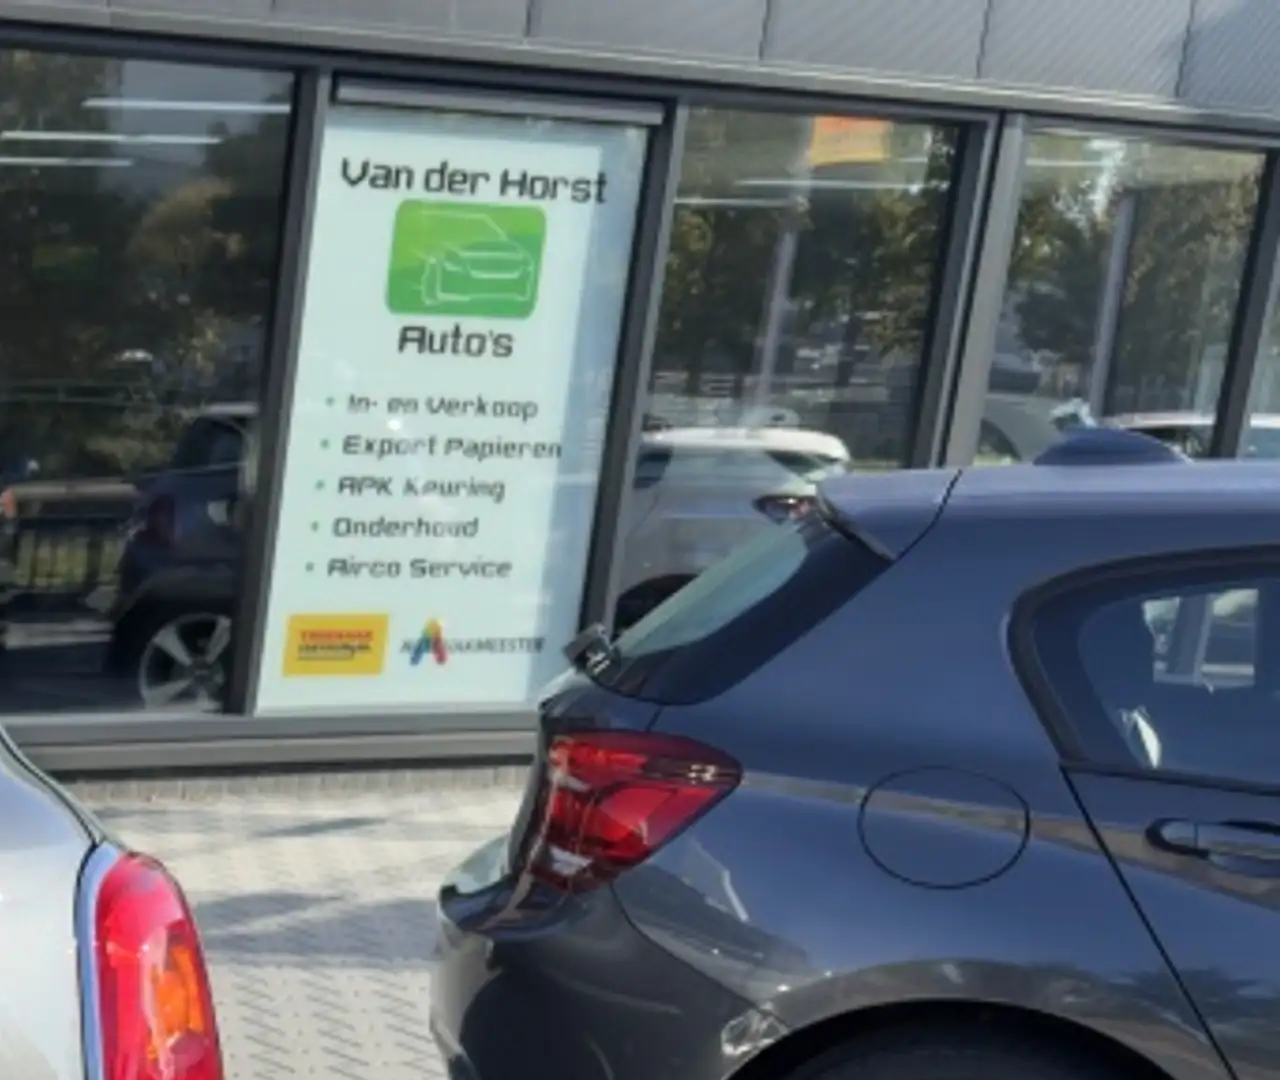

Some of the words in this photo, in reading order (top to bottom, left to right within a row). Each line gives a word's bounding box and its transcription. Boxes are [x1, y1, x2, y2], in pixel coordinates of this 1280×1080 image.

[341, 158, 414, 190] Van
[424, 162, 490, 195] der
[499, 169, 607, 203] Horst
[397, 324, 514, 358] Auto's
[387, 399, 419, 414] en
[342, 434, 436, 459] Export
[444, 437, 563, 461] Papieren
[338, 476, 393, 496] APK
[403, 477, 506, 503] Keuring
[332, 517, 480, 537] Onderhoud
[327, 557, 402, 577] Airco
[409, 557, 513, 578] Service
